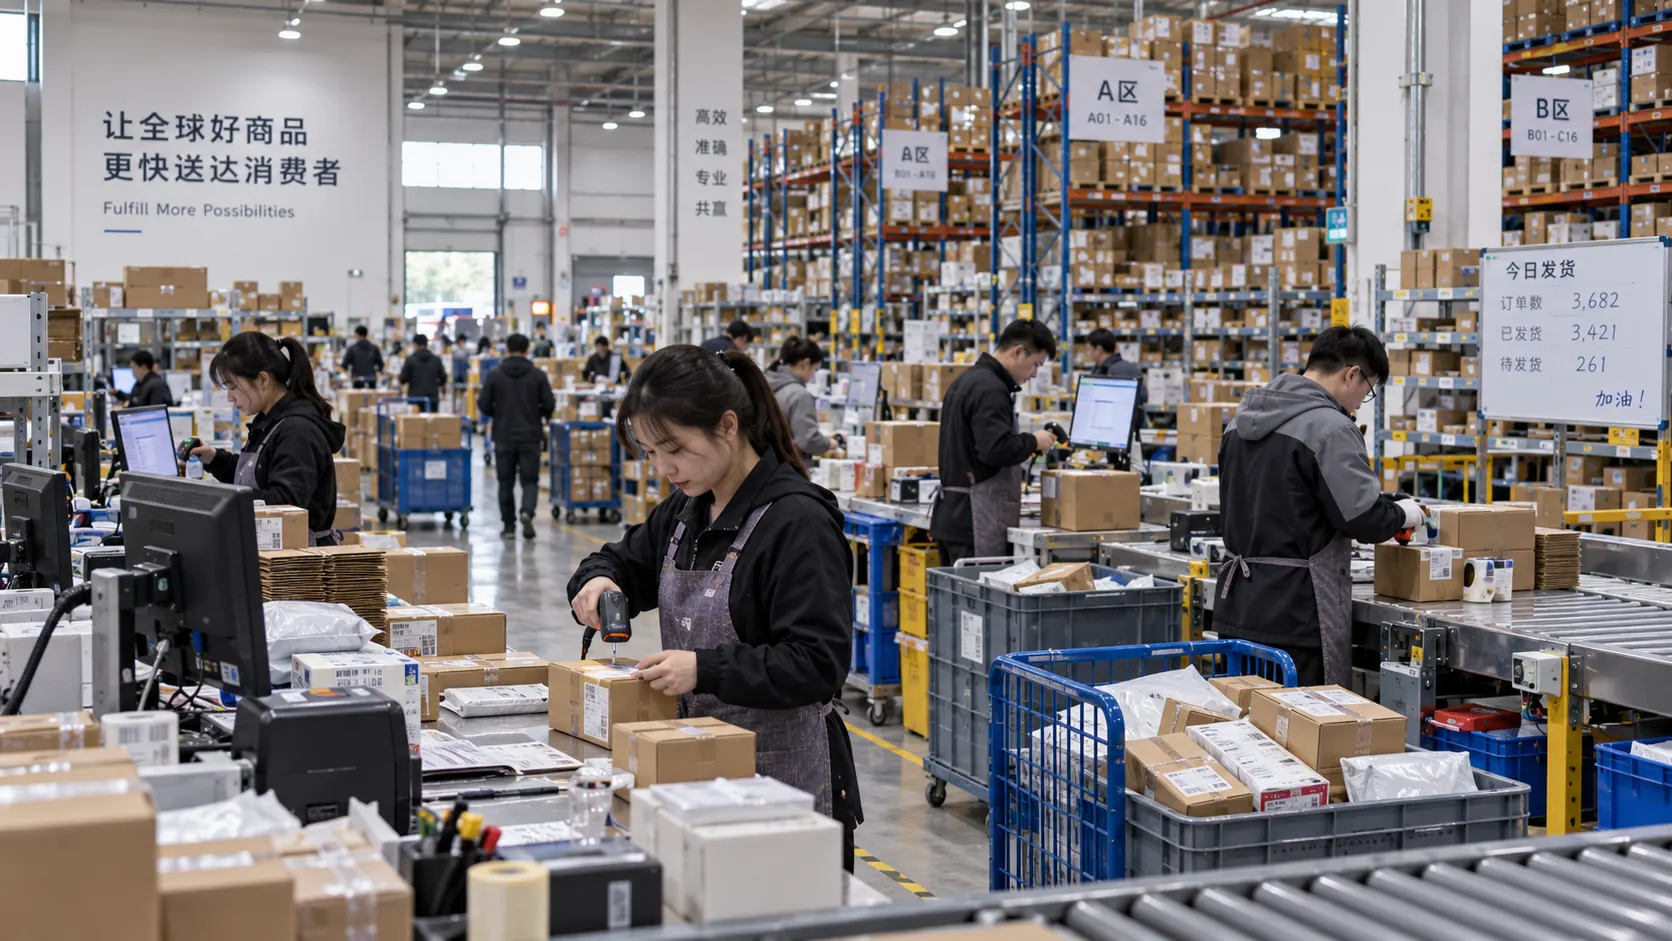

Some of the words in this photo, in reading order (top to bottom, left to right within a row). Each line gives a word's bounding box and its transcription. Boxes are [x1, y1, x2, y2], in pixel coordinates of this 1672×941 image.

[1097, 80, 1138, 103] A区
[695, 108, 728, 126] 高效
[1536, 98, 1570, 121] B区
[103, 110, 308, 146] 让全球好商品
[695, 138, 727, 156] 准确
[901, 146, 930, 163] A区
[103, 152, 341, 187] 更快送达消费者
[695, 169, 728, 186] 专业
[103, 202, 149, 216] Fulfill
[156, 203, 196, 217] More
[203, 204, 295, 218] Possibilities
[1506, 259, 1576, 281] 今日发货
[1500, 295, 1543, 311] 订单数
[1571, 292, 1620, 311] 3,682
[1500, 326, 1543, 342] 已发货
[1571, 324, 1617, 343] 3,421
[1500, 356, 1543, 373] 待发货
[1575, 356, 1607, 373] 261
